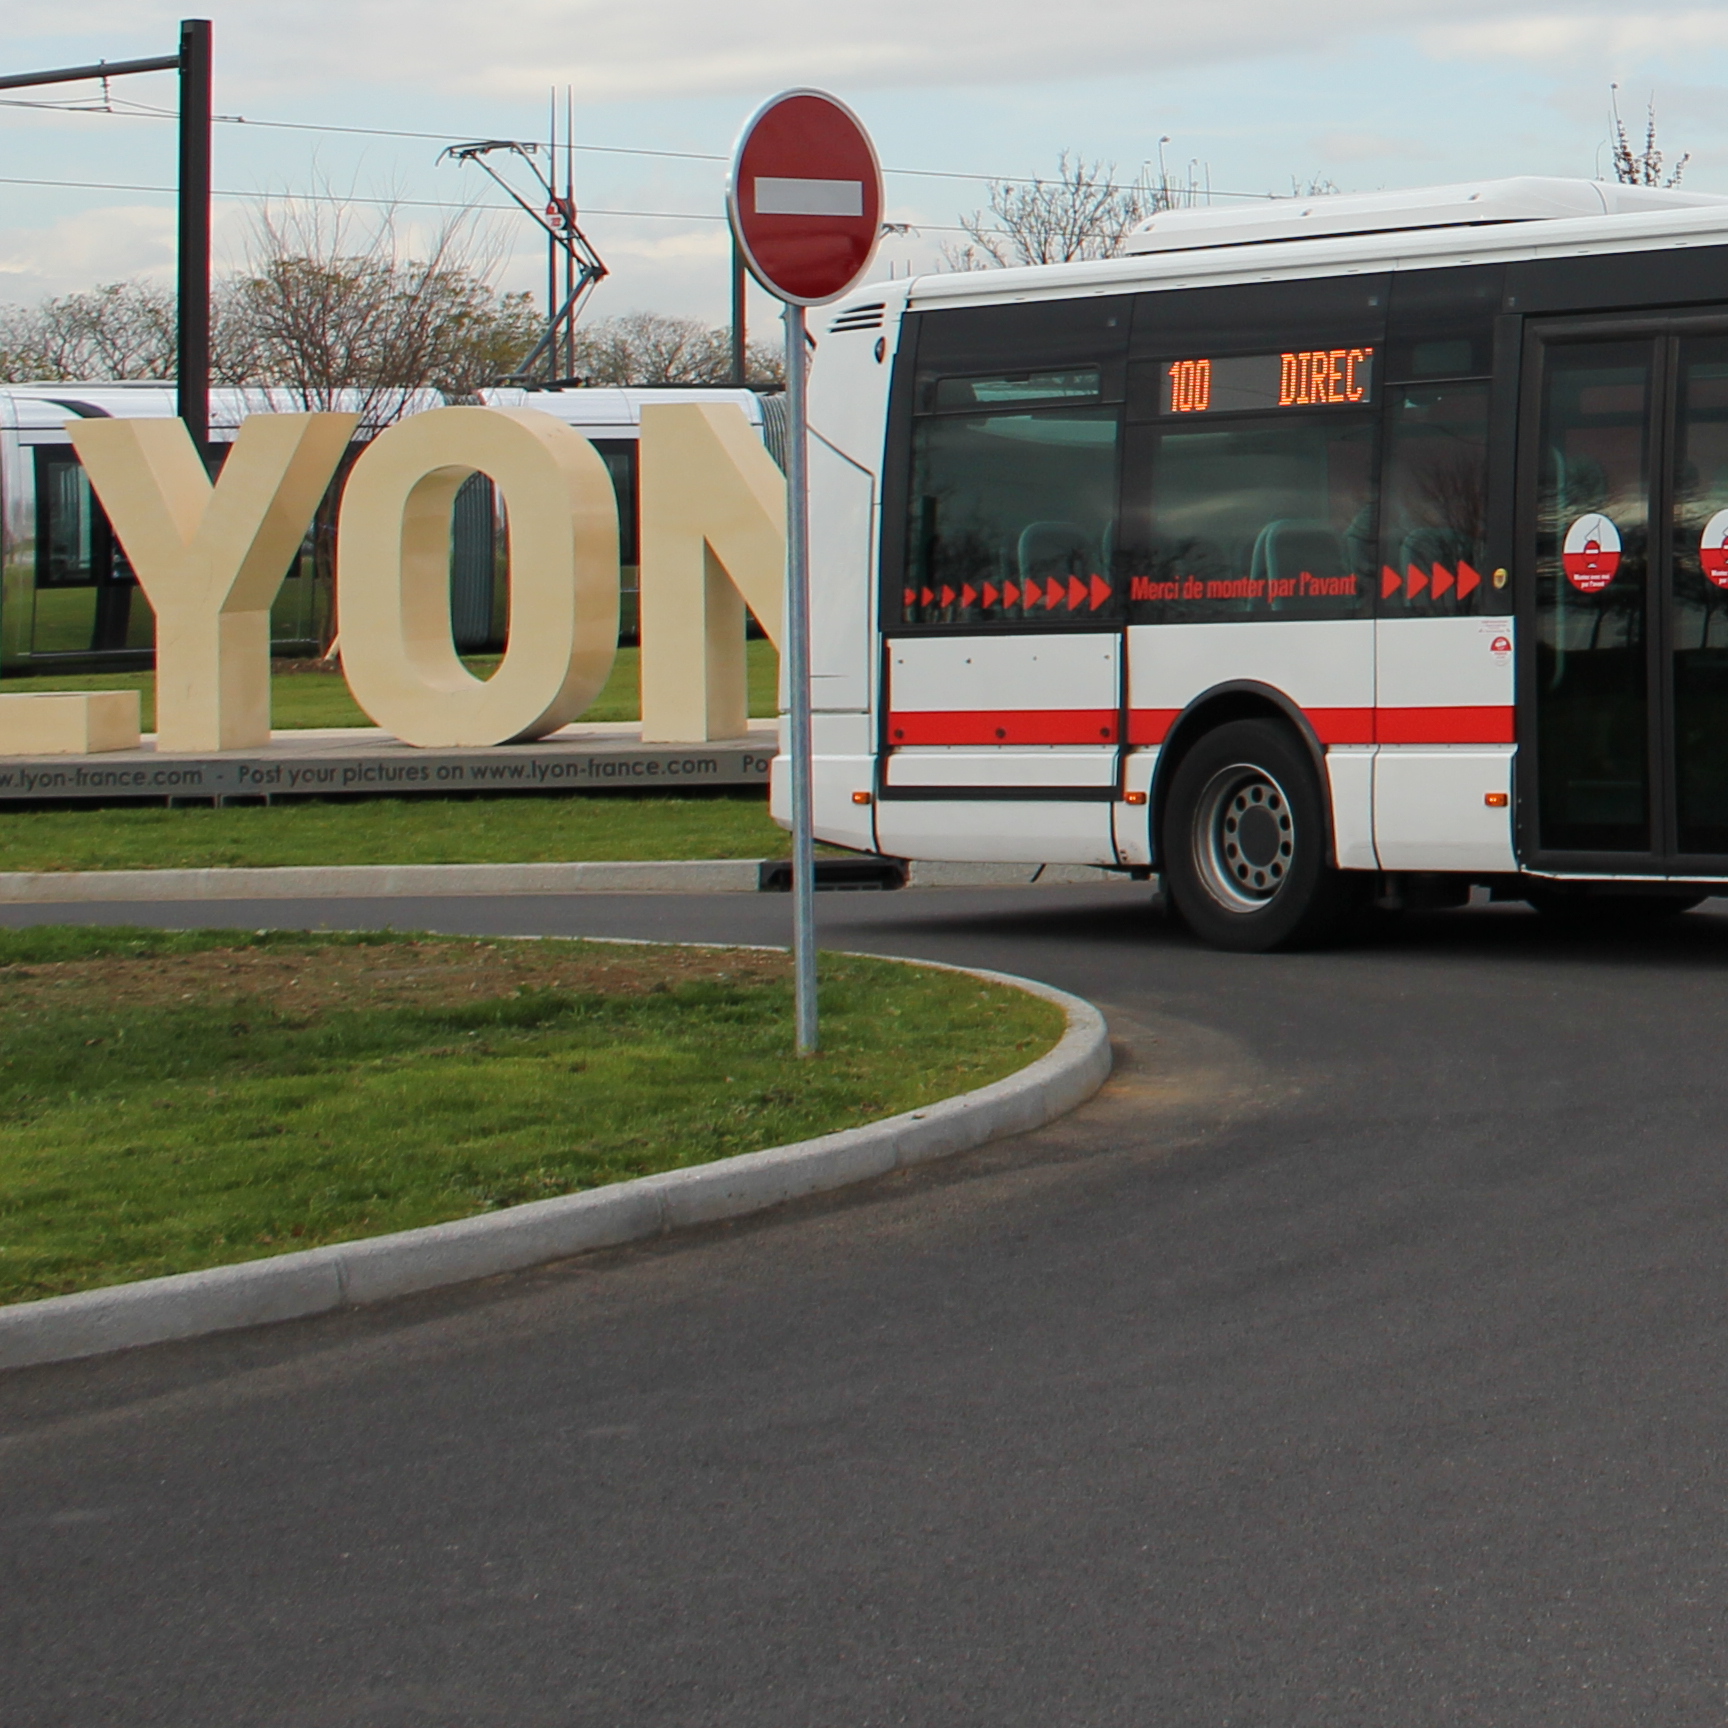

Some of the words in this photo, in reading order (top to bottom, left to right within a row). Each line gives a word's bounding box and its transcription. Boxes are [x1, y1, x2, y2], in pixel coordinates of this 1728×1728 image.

[1168, 359, 1211, 412] 100
[1279, 347, 1374, 406] DIREC
[0, 403, 786, 754] YON
[1130, 575, 1180, 601] Merci
[1183, 574, 1204, 600] de
[1206, 576, 1266, 600] monter
[1267, 577, 1298, 604] par
[1299, 571, 1359, 597] l'avant
[238, 764, 281, 786] Post
[288, 767, 337, 789] your
[343, 762, 430, 788] pictures
[436, 765, 464, 780] on
[469, 755, 718, 784] www.lyon-france.com
